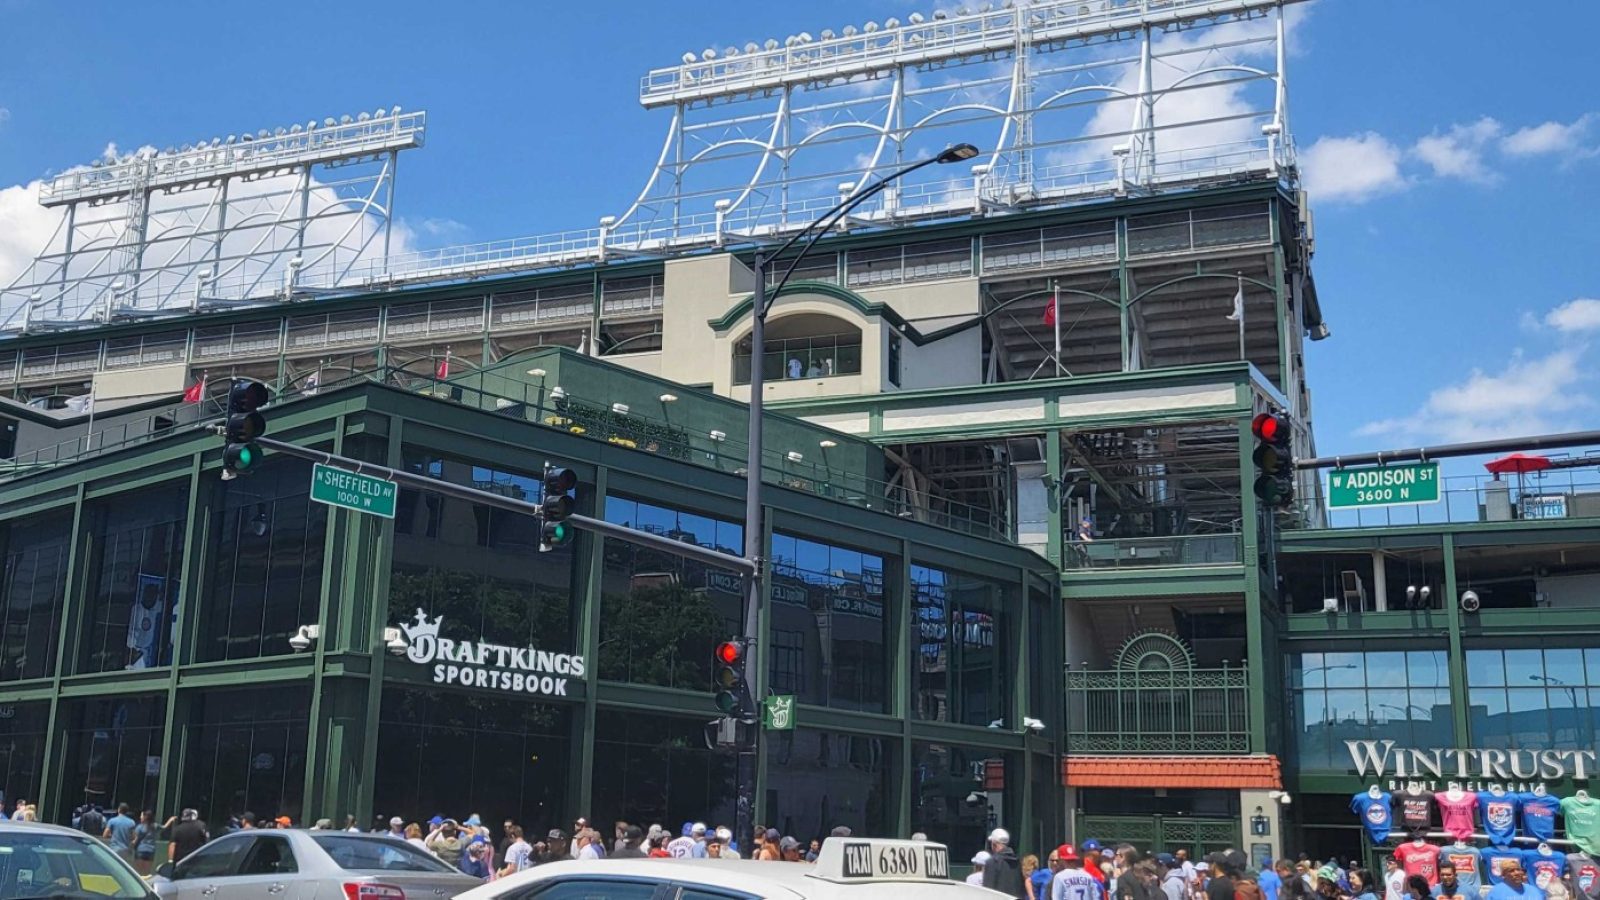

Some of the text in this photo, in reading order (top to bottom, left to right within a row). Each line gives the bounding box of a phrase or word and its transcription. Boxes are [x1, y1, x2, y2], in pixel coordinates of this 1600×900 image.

[316, 471, 392, 498] N SHEFFIELD AV
[1333, 468, 1434, 489] W ADDISON ST
[337, 491, 372, 507] 1000 W
[1357, 488, 1409, 502] 3600 N
[407, 633, 585, 676] DRAFTKINGS
[433, 664, 568, 696] SPORTSBOOK
[1343, 739, 1596, 780] WINTRUST
[846, 846, 947, 877] TAXI 6380 TAXI
